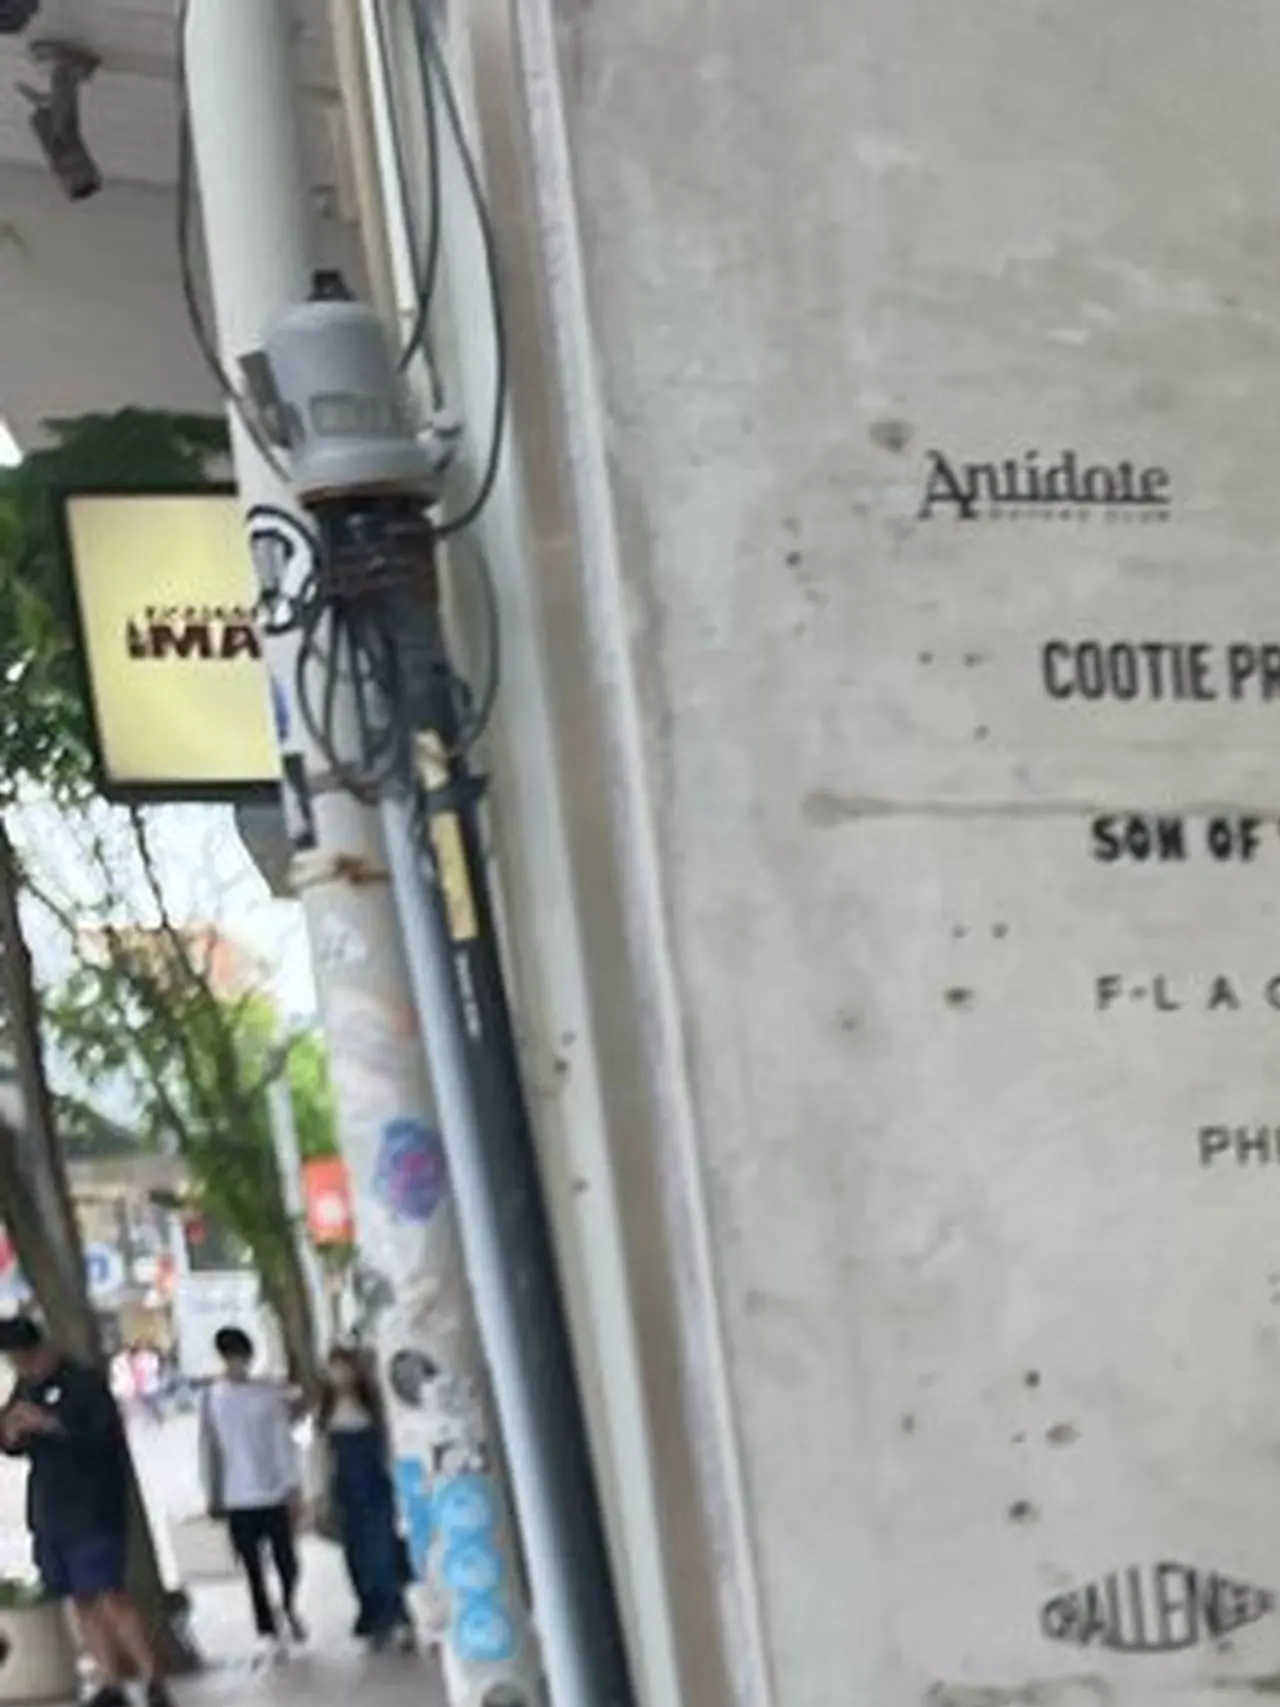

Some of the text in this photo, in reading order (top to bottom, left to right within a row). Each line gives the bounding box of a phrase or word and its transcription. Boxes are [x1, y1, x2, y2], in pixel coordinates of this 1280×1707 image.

[917, 449, 1171, 520] Antidote
[1042, 641, 1216, 700] COOTIE
[1091, 815, 1187, 862] SON
[1206, 817, 1262, 862] OF
